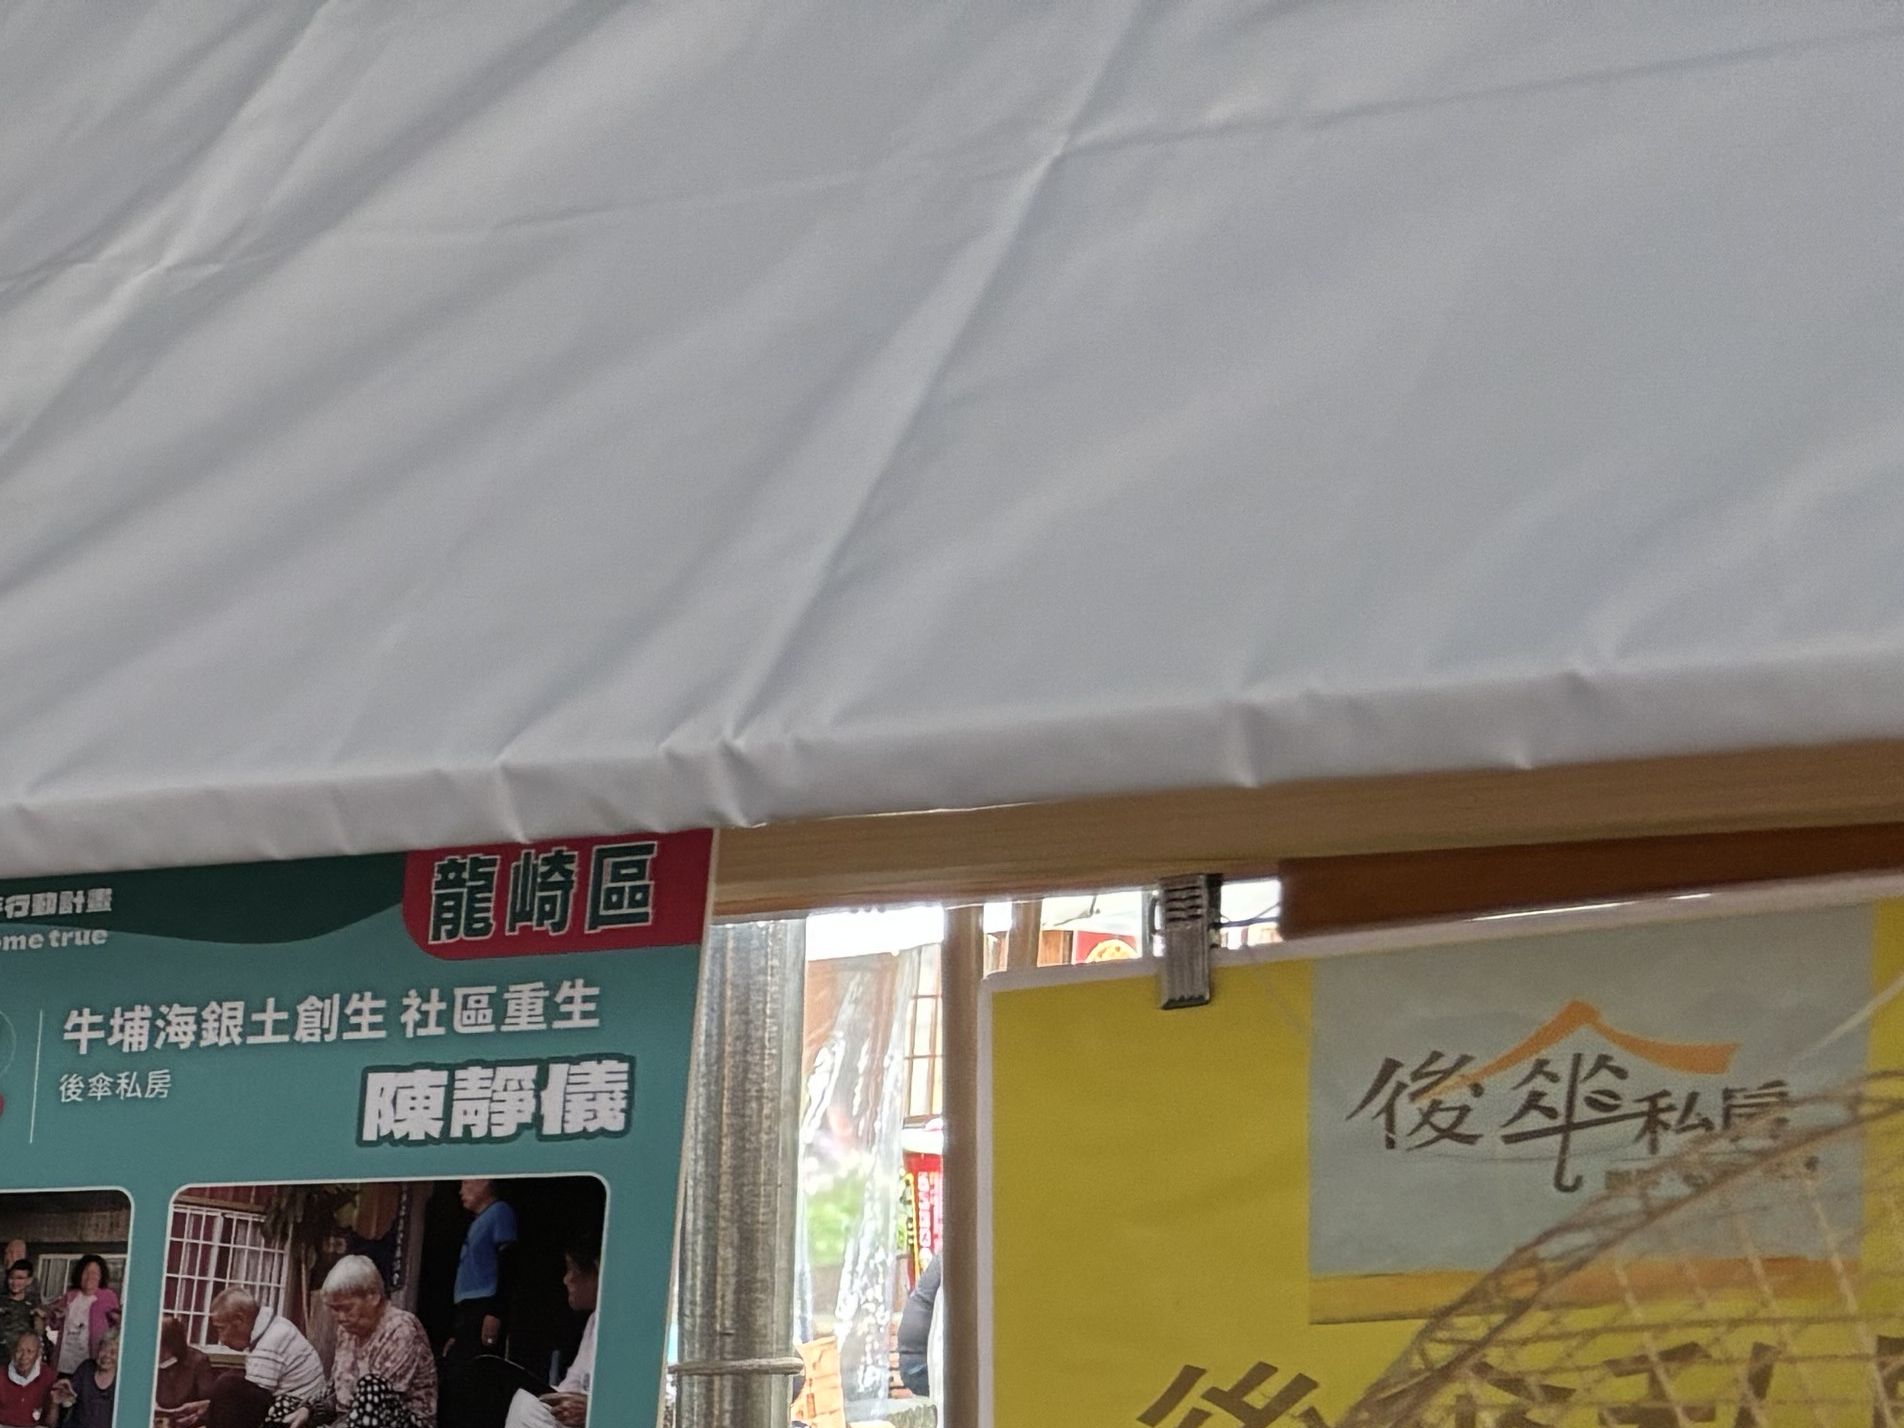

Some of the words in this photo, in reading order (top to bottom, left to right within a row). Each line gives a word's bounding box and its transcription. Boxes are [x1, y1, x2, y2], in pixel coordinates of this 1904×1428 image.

[428, 840, 659, 945] 龍崎區
[48, 927, 109, 947] true
[62, 989, 388, 1055] 牛埔海銀土創生
[399, 978, 603, 1040] 社區重生
[58, 1069, 173, 1103] 後傘私房
[361, 1059, 630, 1143] 陳靜儀
